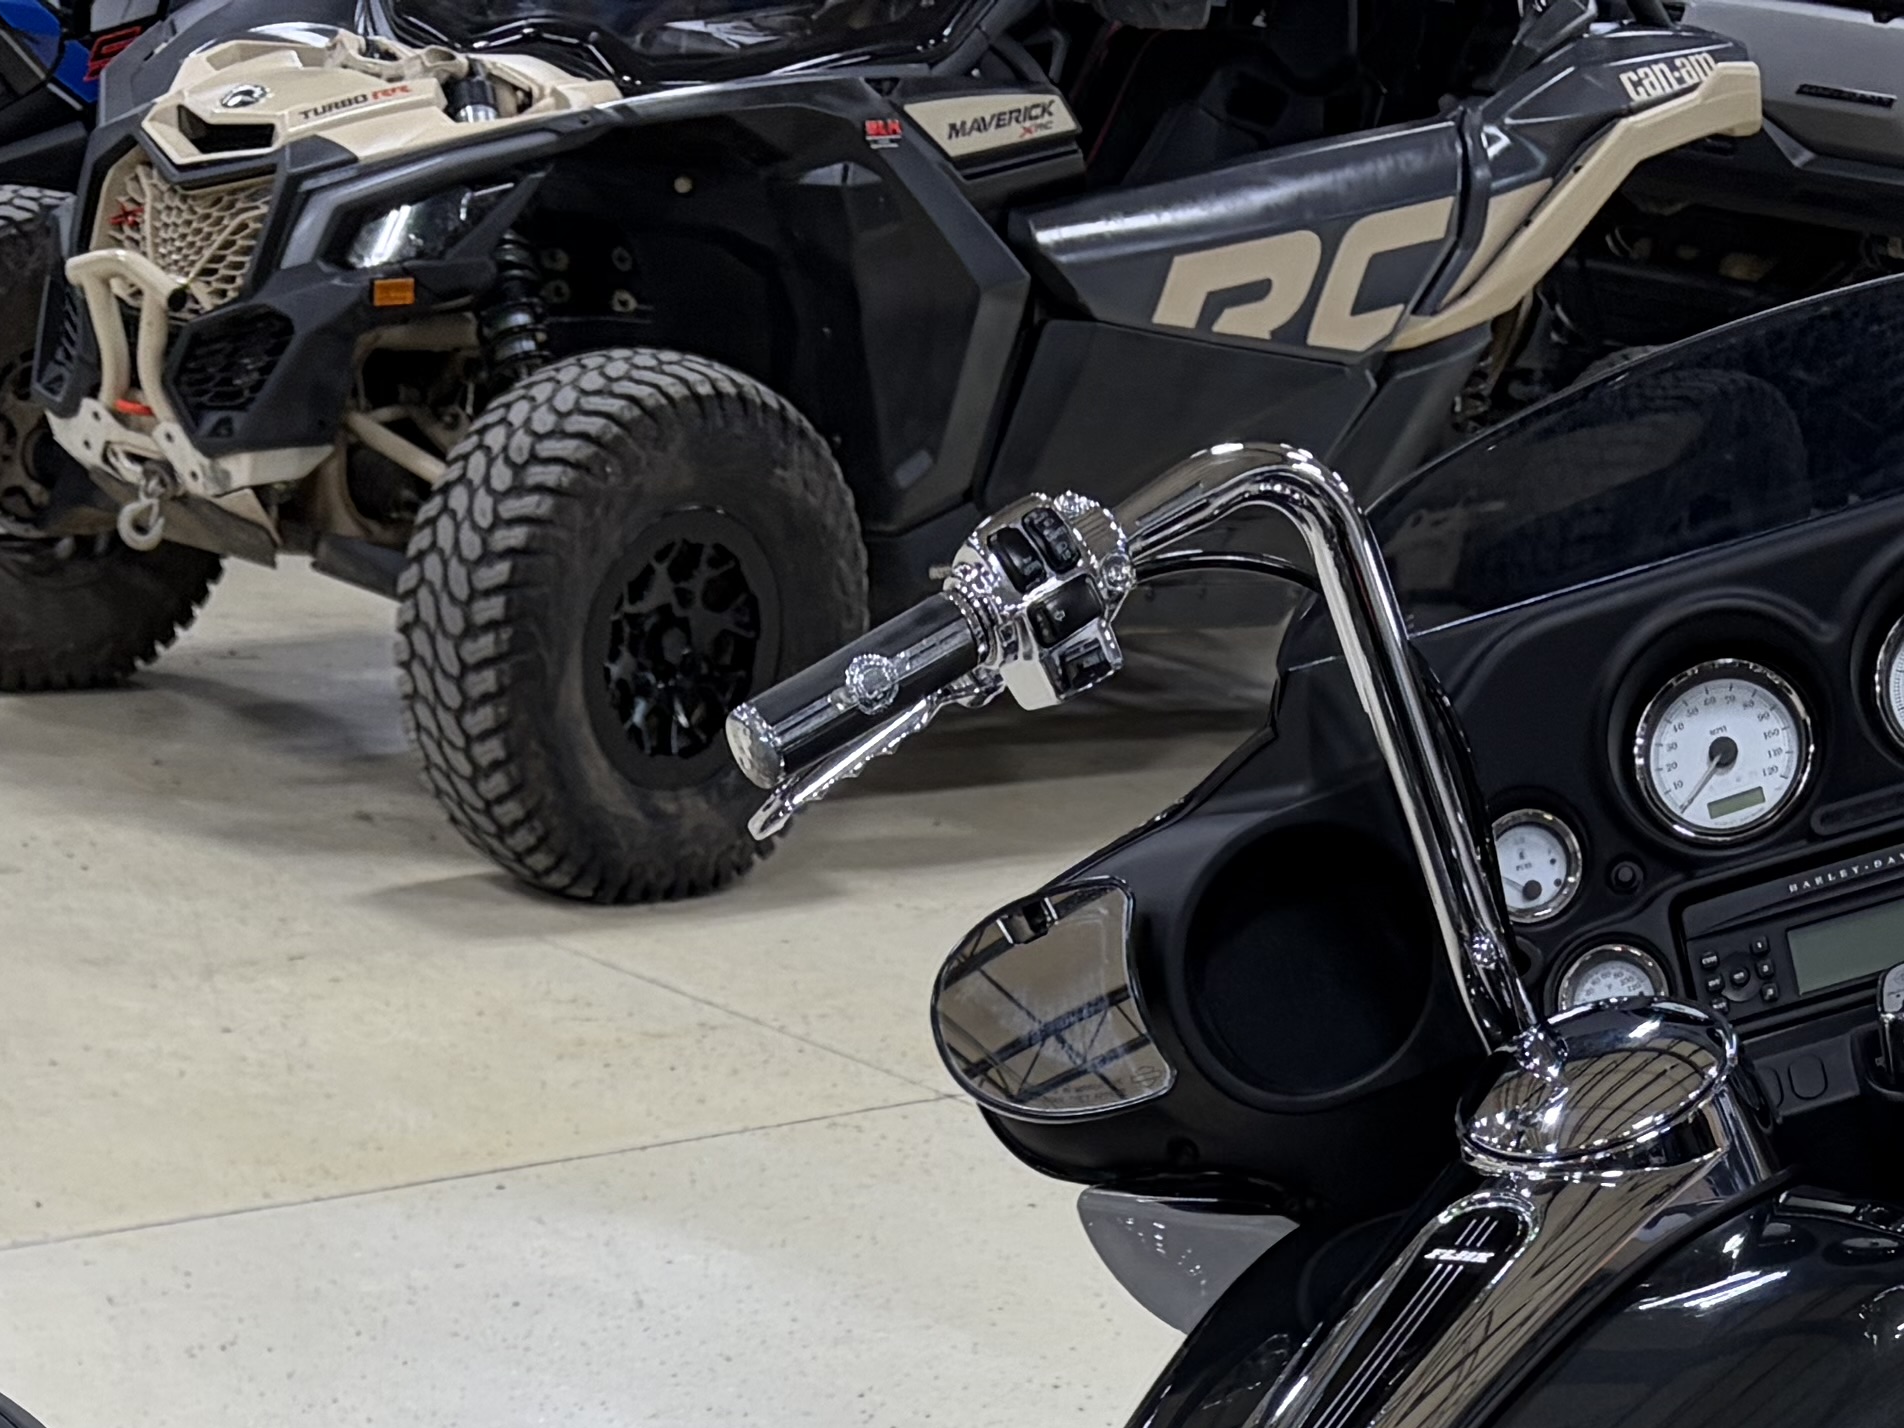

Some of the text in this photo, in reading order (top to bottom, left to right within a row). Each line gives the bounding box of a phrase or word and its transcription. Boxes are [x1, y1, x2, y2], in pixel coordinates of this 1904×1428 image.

[298, 93, 369, 120] TURBO
[947, 99, 1055, 140] MAVERICK
[1672, 779, 1684, 791] 10
